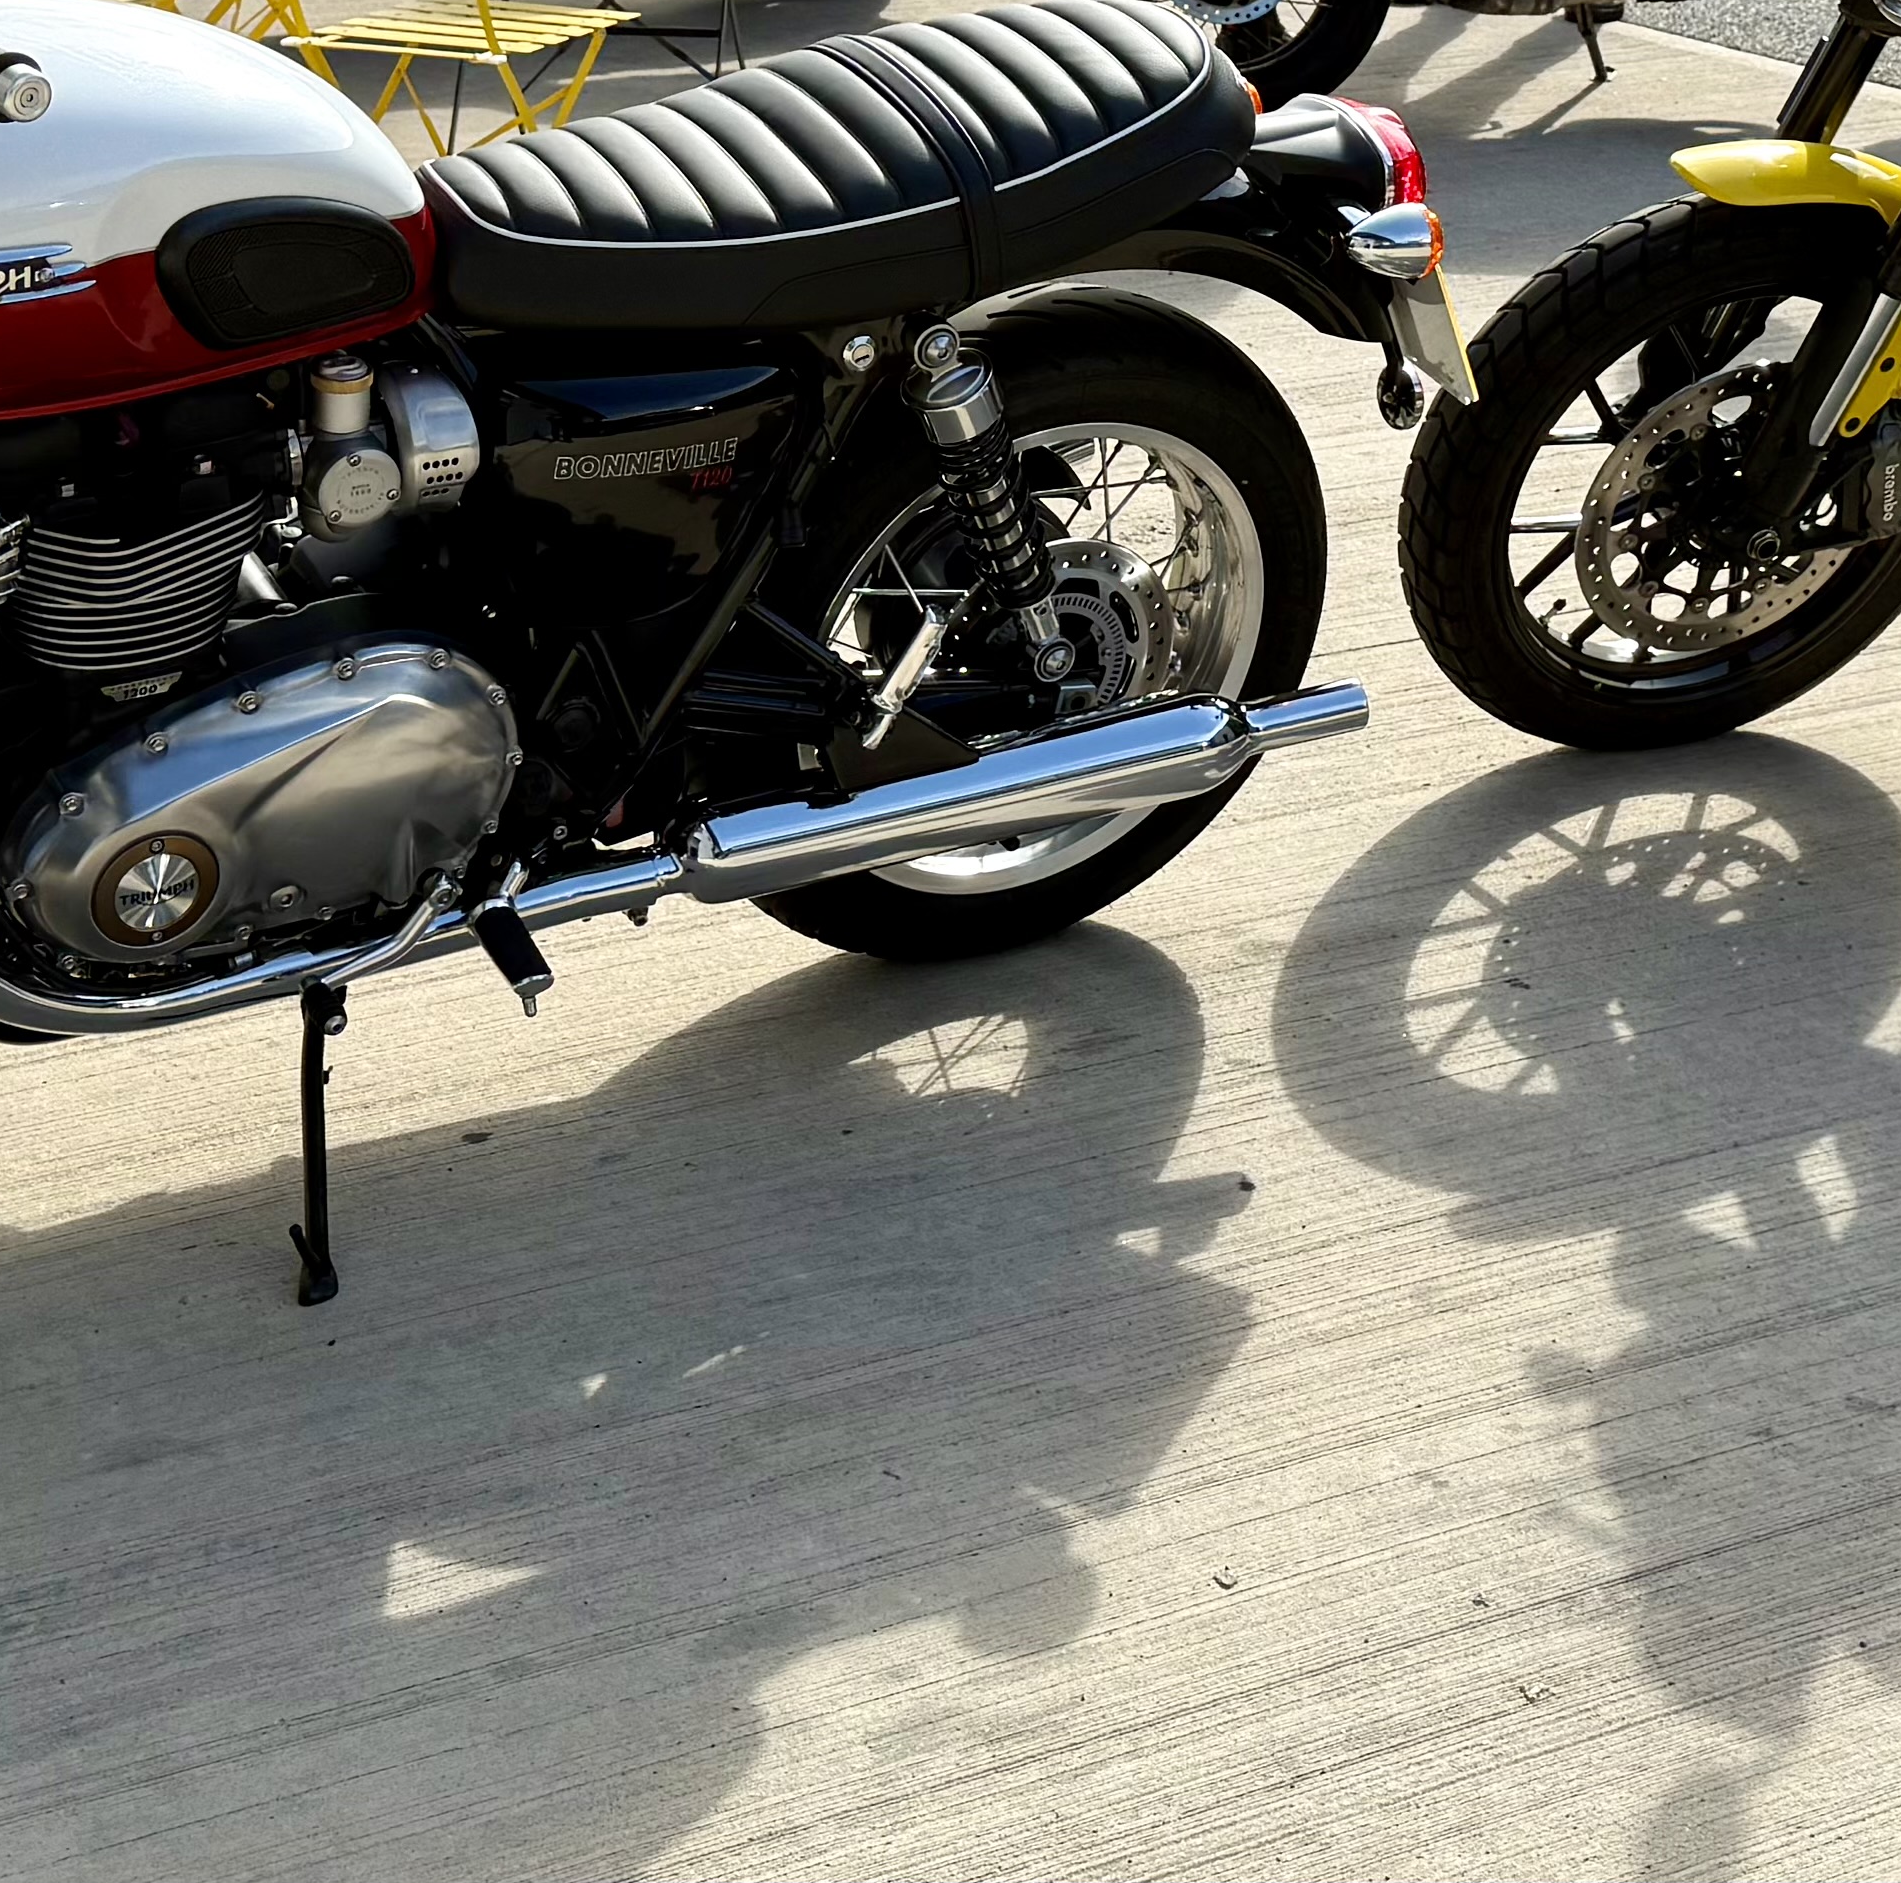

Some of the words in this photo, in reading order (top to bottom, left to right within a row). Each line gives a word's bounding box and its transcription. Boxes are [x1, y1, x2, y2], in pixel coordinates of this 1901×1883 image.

[554, 437, 739, 480] BONNEVILLE
[1882, 462, 1900, 522] brembo
[123, 683, 158, 699] 1200
[119, 878, 195, 906] TRIUMPH
